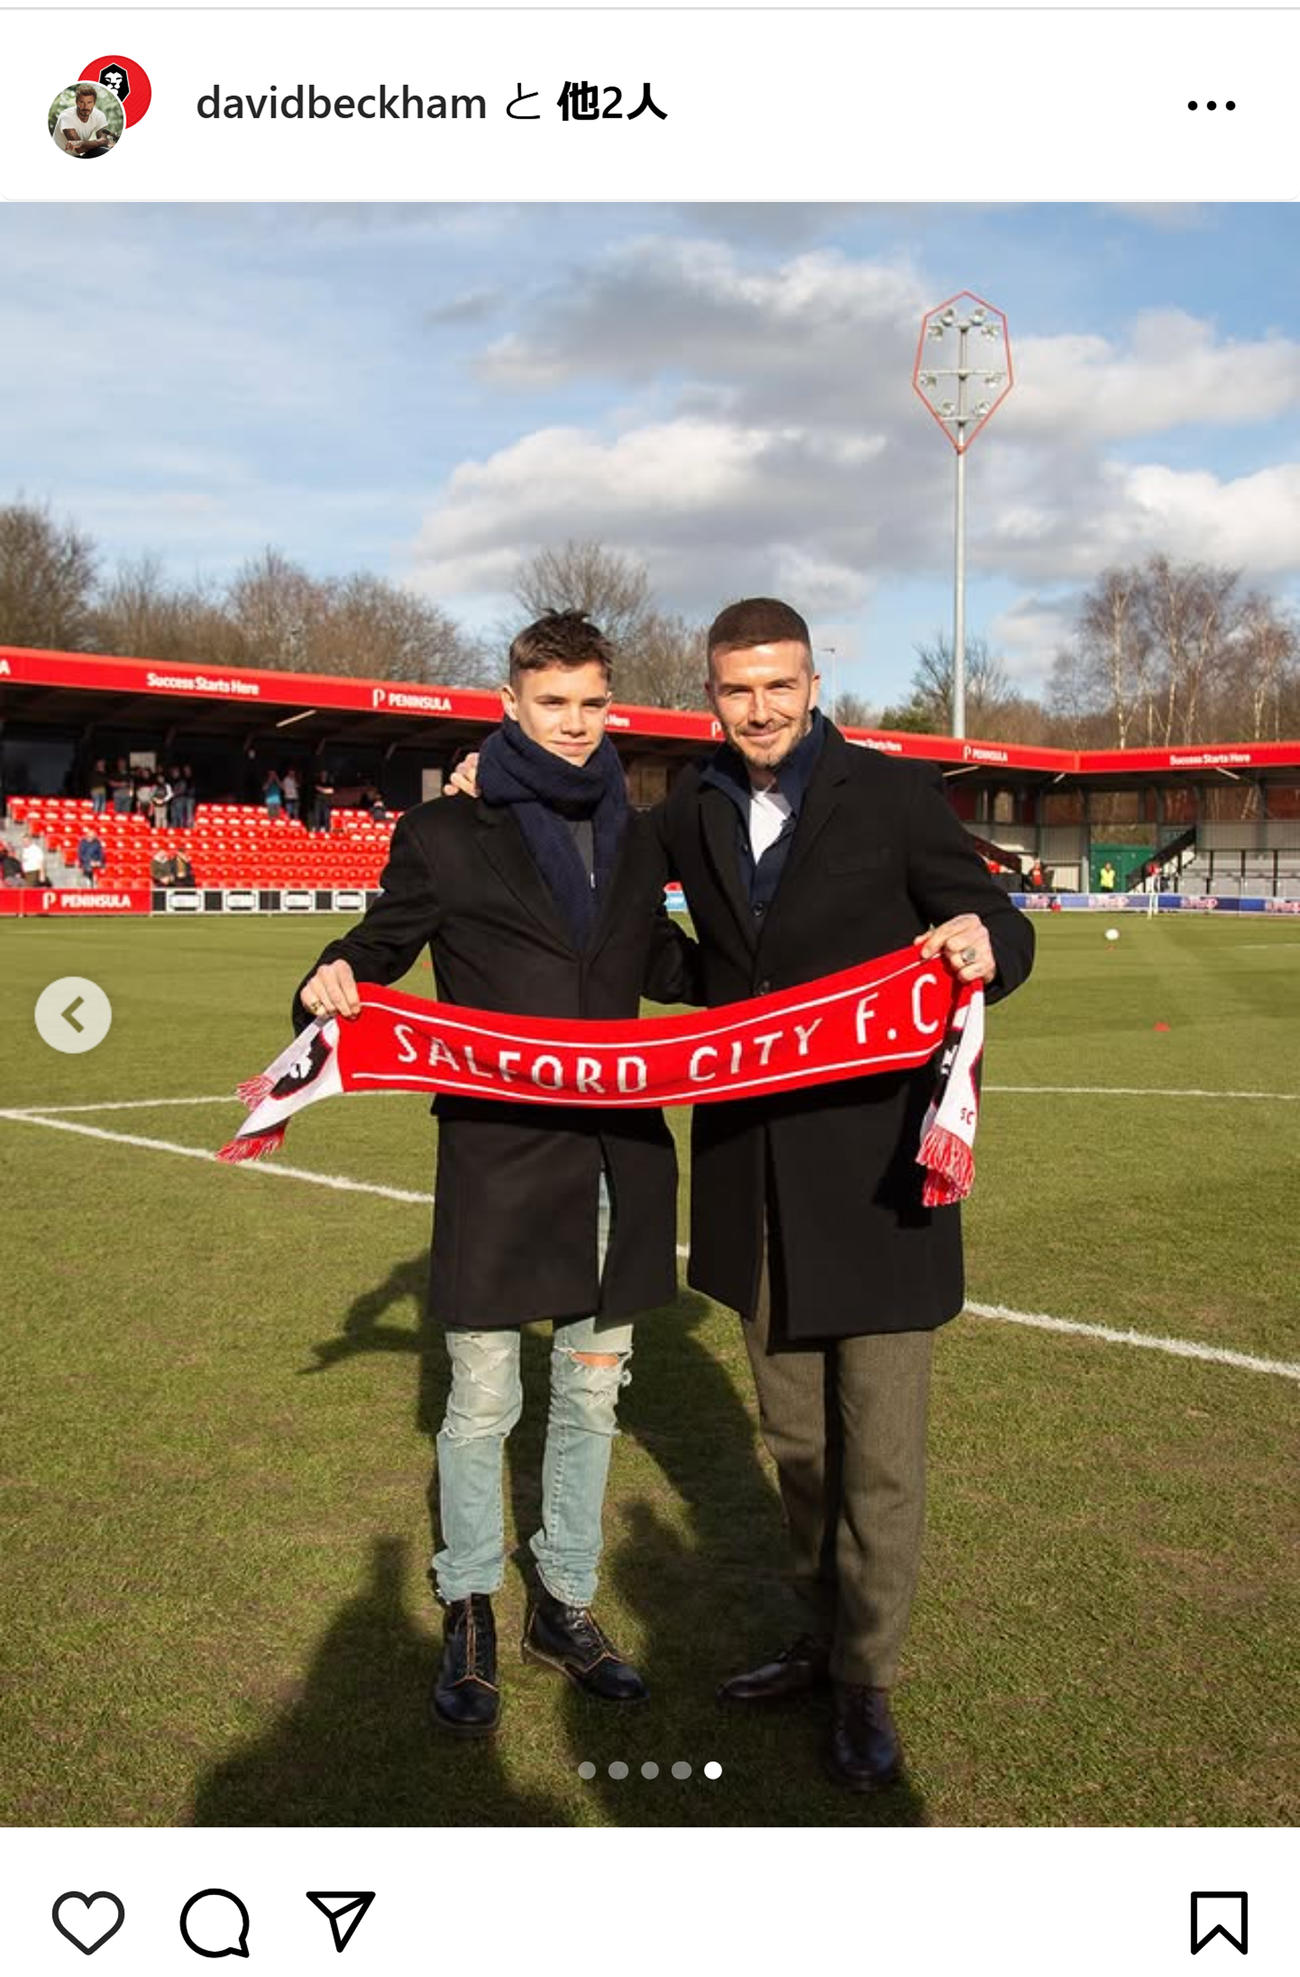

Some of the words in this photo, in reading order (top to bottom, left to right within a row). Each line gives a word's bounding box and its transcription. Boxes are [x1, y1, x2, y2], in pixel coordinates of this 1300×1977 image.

[146, 673, 195, 690] Success
[195, 676, 230, 692] Starts
[230, 679, 260, 695] Here
[388, 692, 452, 711] PENINSULA
[61, 894, 131, 908] PENINSULA
[393, 1023, 648, 1094] SALFORD
[688, 1017, 823, 1081] CITY
